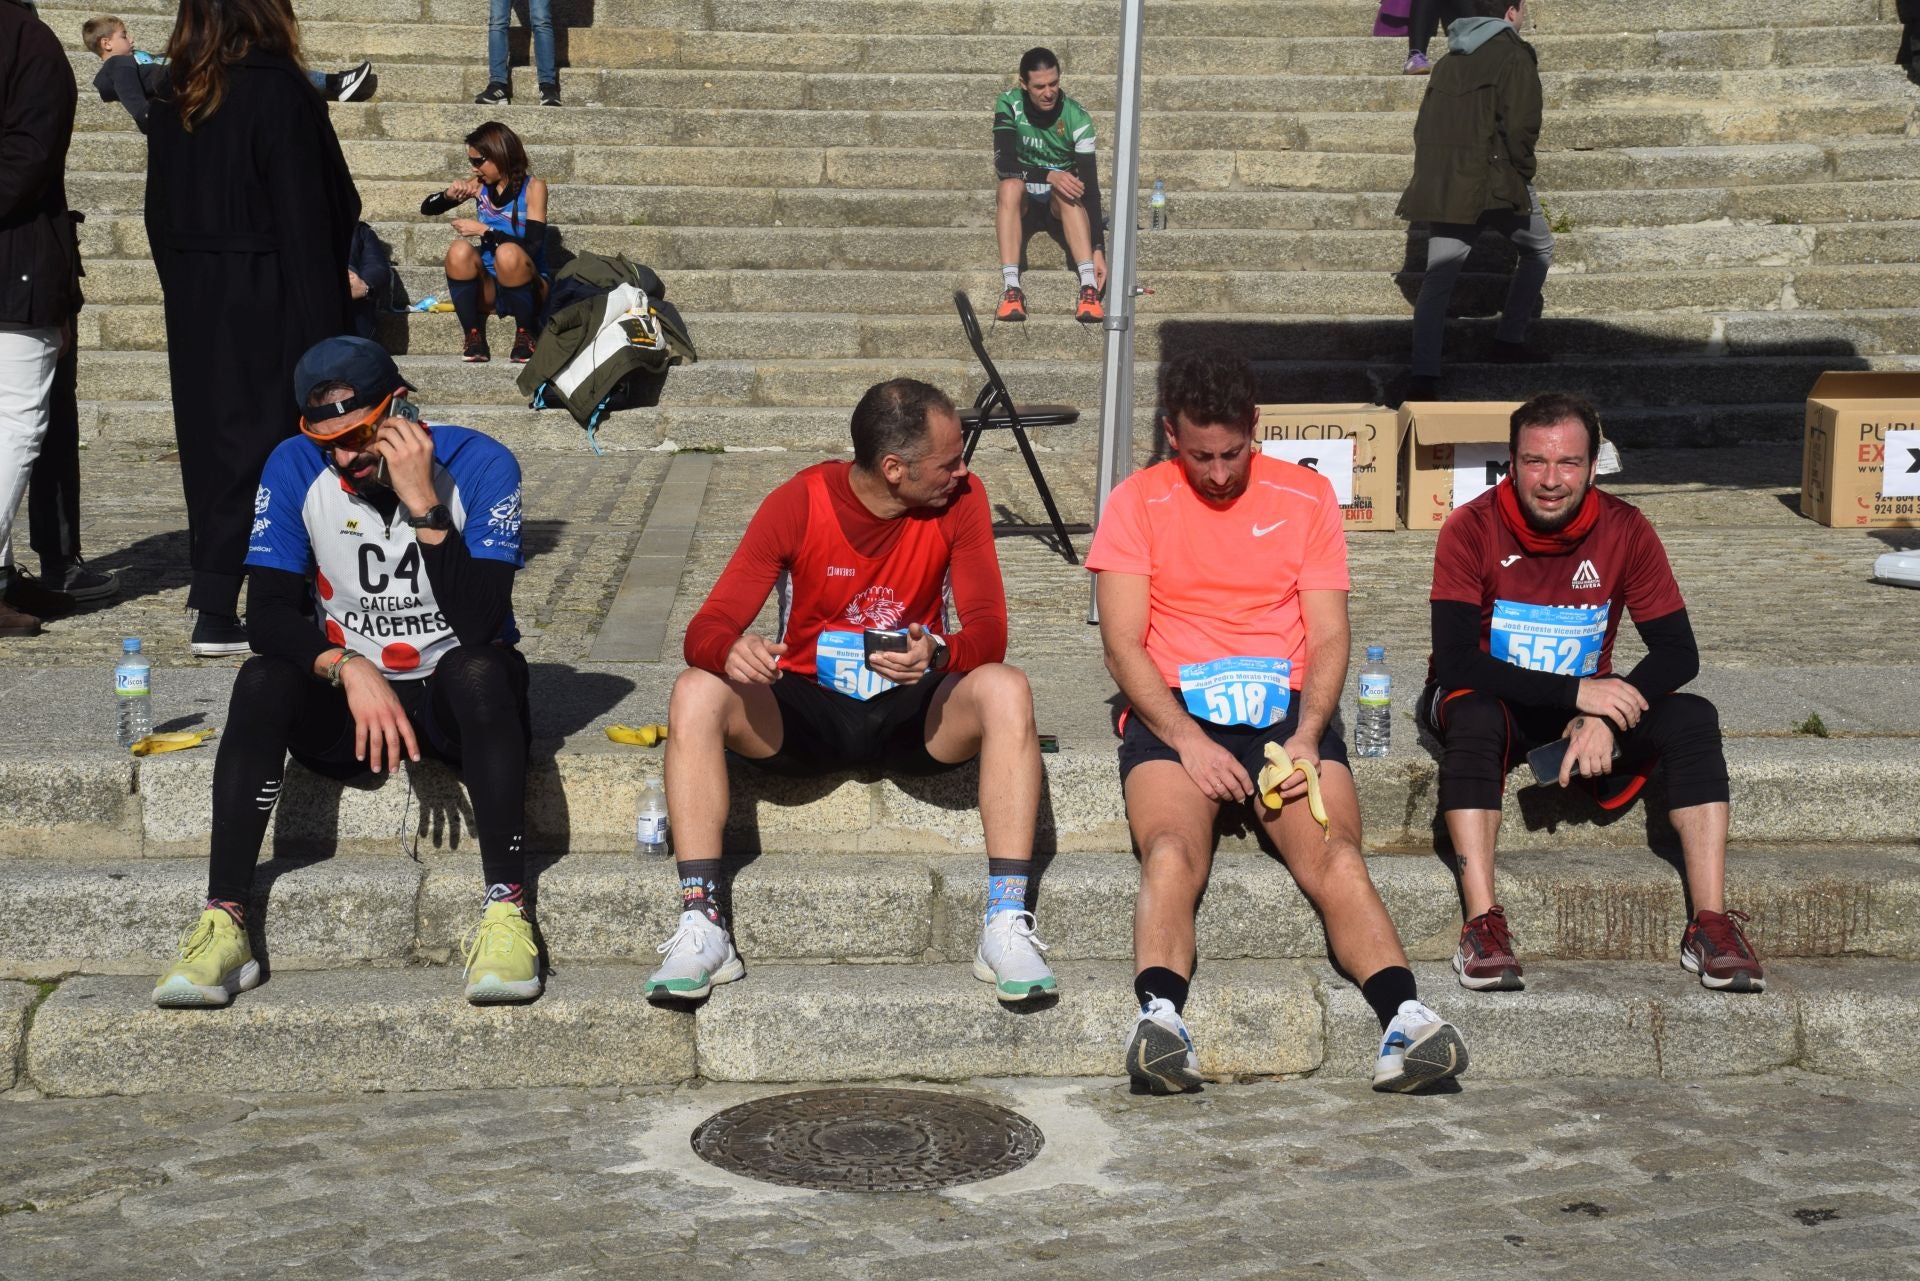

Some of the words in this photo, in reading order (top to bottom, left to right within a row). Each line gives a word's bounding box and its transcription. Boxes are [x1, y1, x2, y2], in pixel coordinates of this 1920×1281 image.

[1875, 504, 1892, 514] 924
[1895, 504, 1913, 514] 804
[358, 542, 420, 594] C4
[360, 597, 423, 611] CATELSA
[1508, 633, 1581, 675] 552
[1204, 682, 1267, 725] 518
